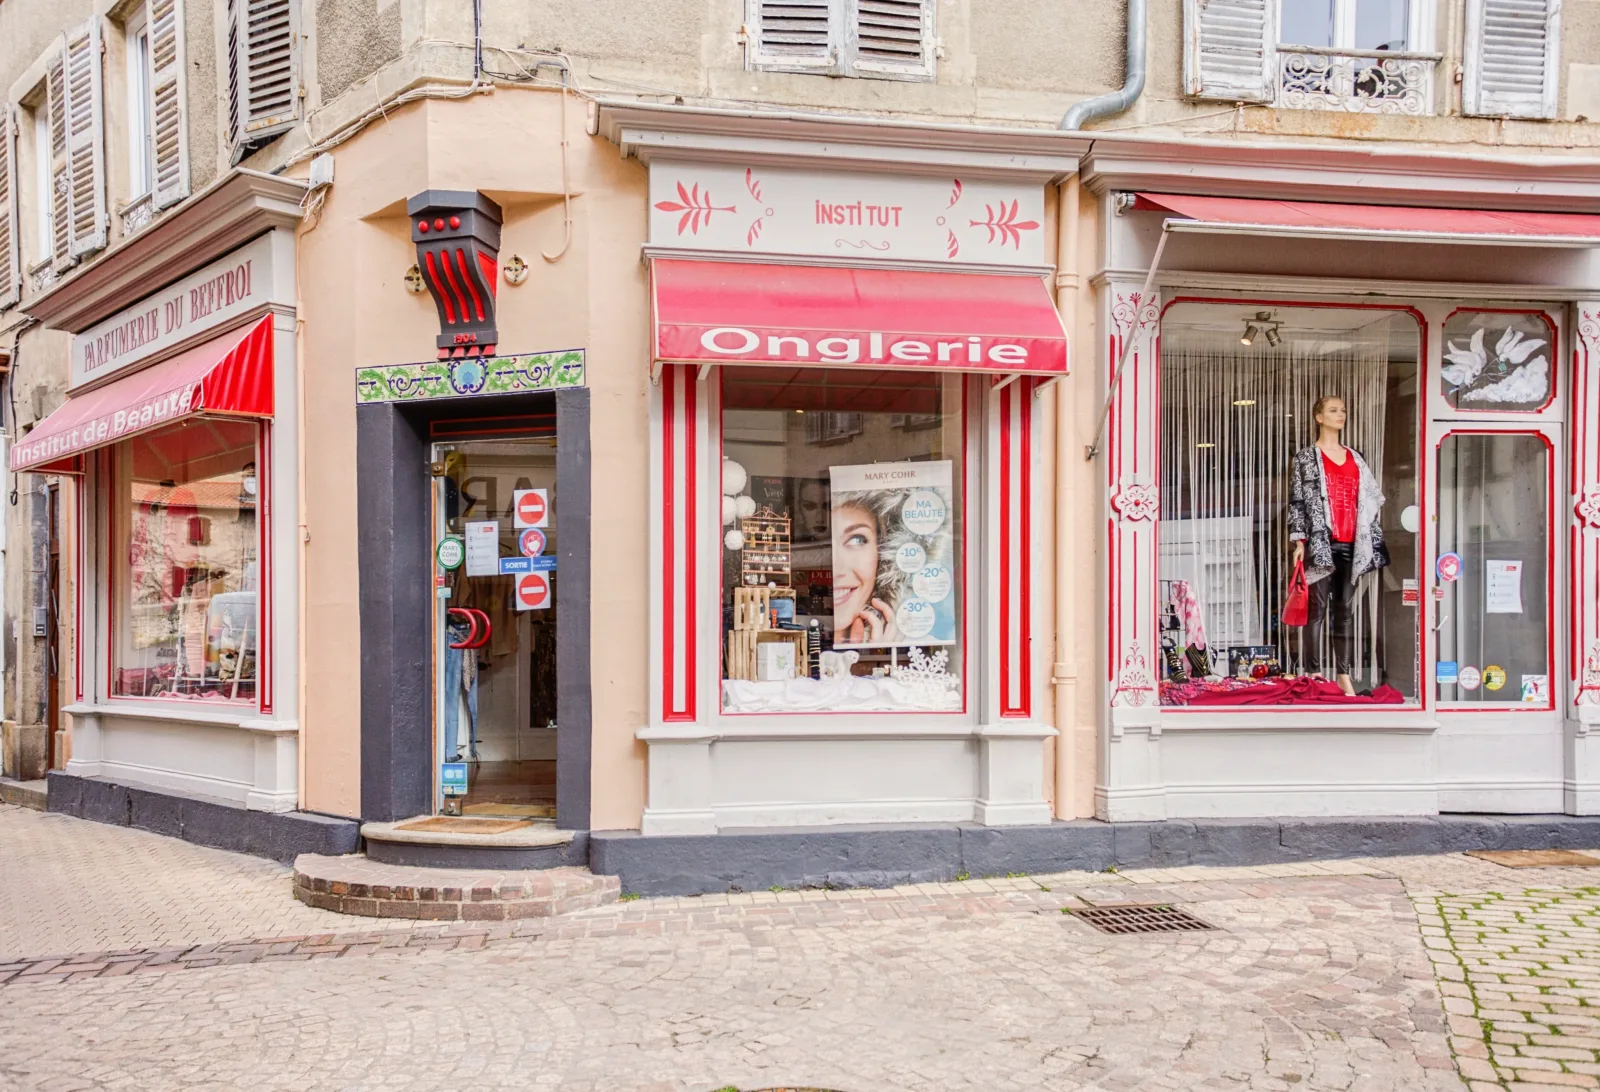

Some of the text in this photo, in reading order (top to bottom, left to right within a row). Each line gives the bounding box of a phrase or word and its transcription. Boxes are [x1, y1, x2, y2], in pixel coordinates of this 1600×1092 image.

[83, 259, 252, 373] PARFUMERIE DU BEFFROI
[700, 327, 1028, 364] Onglerie
[15, 384, 193, 465] Institut de Beauté
[864, 470, 917, 480] MARY COHR
[916, 500, 932, 508] MA
[504, 561, 528, 569] SORTIE
